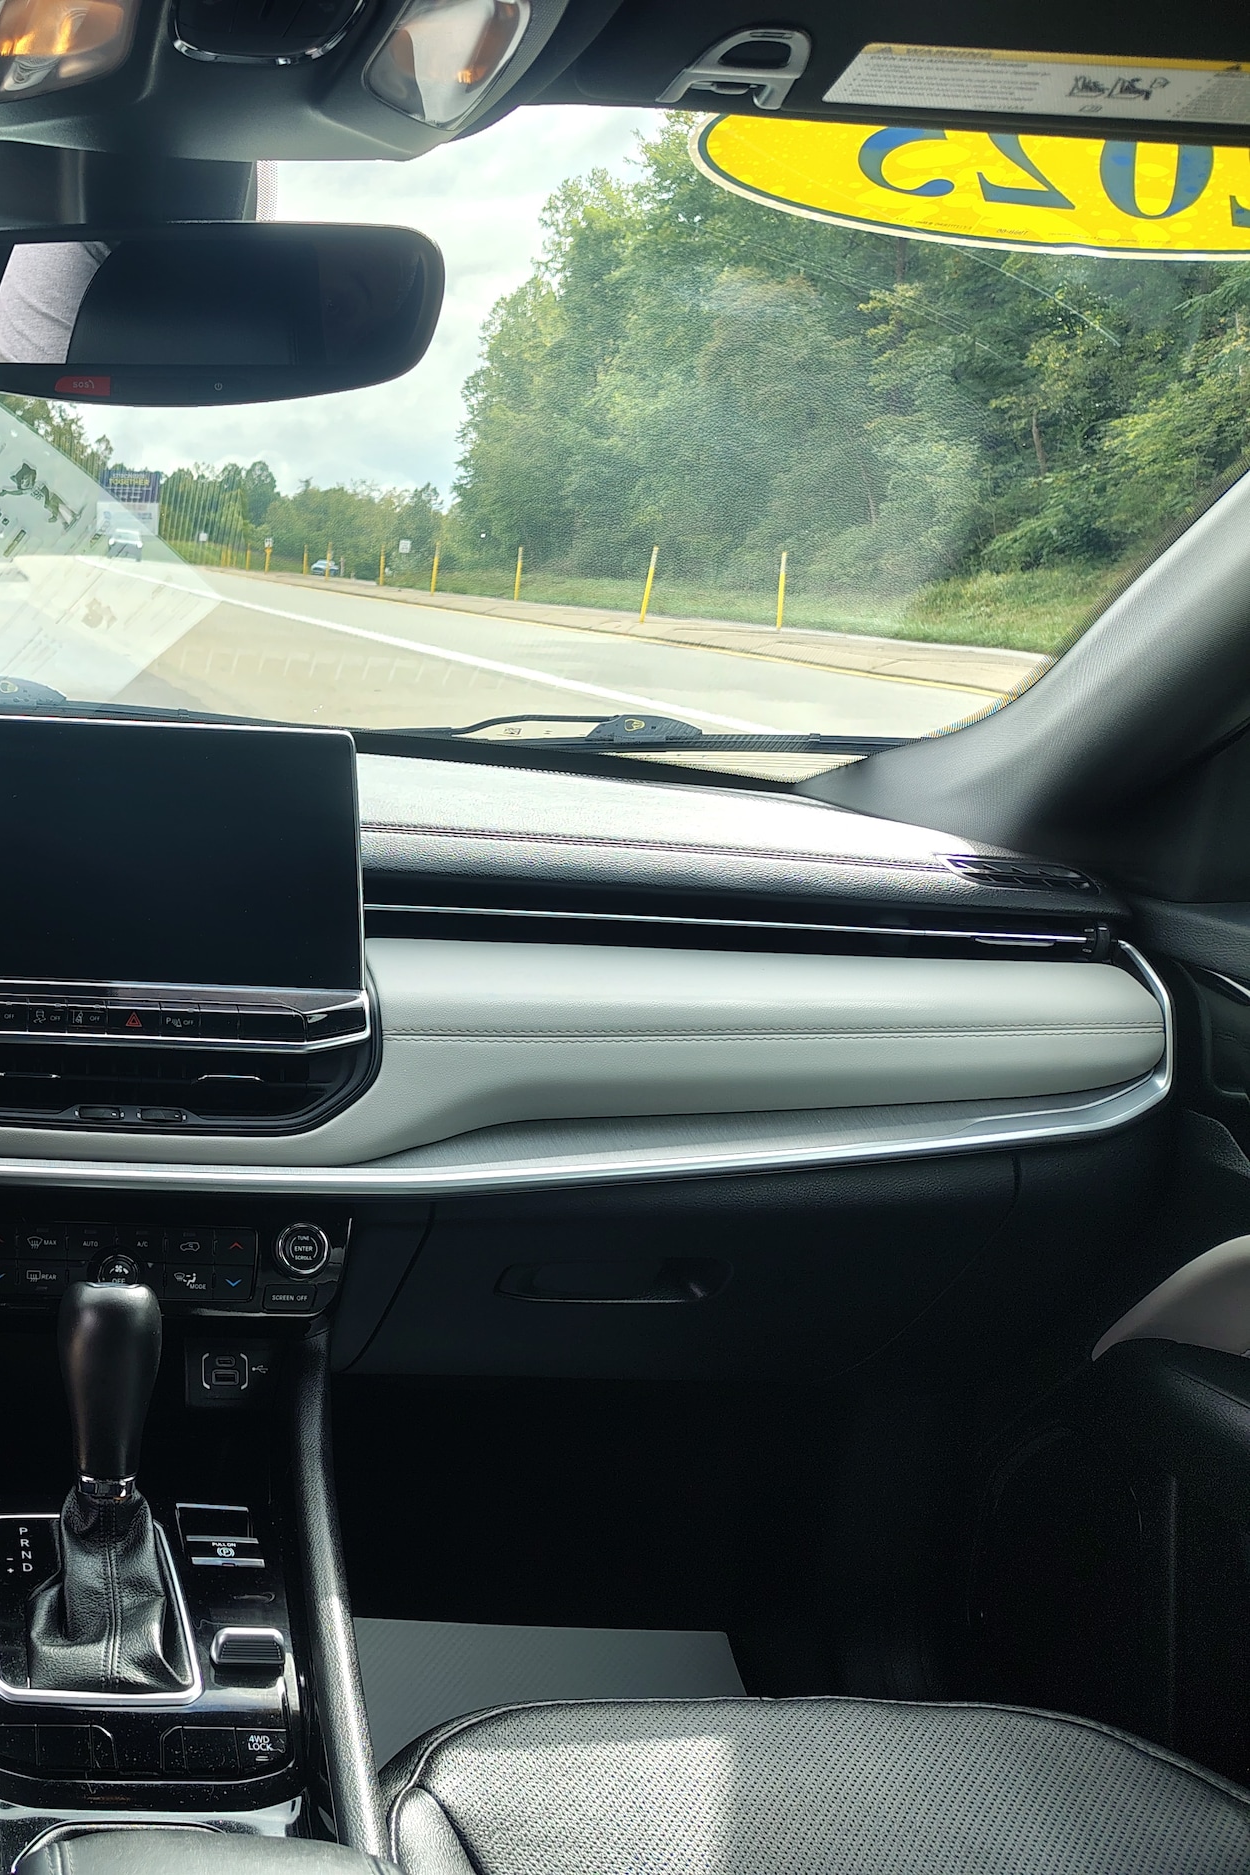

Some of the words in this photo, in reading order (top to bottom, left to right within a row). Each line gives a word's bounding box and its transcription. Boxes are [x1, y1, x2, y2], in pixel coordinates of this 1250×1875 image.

[72, 381, 90, 389] SOS
[82, 1240, 99, 1248] AUTO
[41, 1273, 57, 1281] REAR
[19, 1526, 29, 1536] P
[20, 1538, 30, 1548] R
[21, 1550, 32, 1560] N
[22, 1562, 33, 1572] D
[248, 1734, 270, 1744] 4WD
[247, 1742, 273, 1752] LOCK
